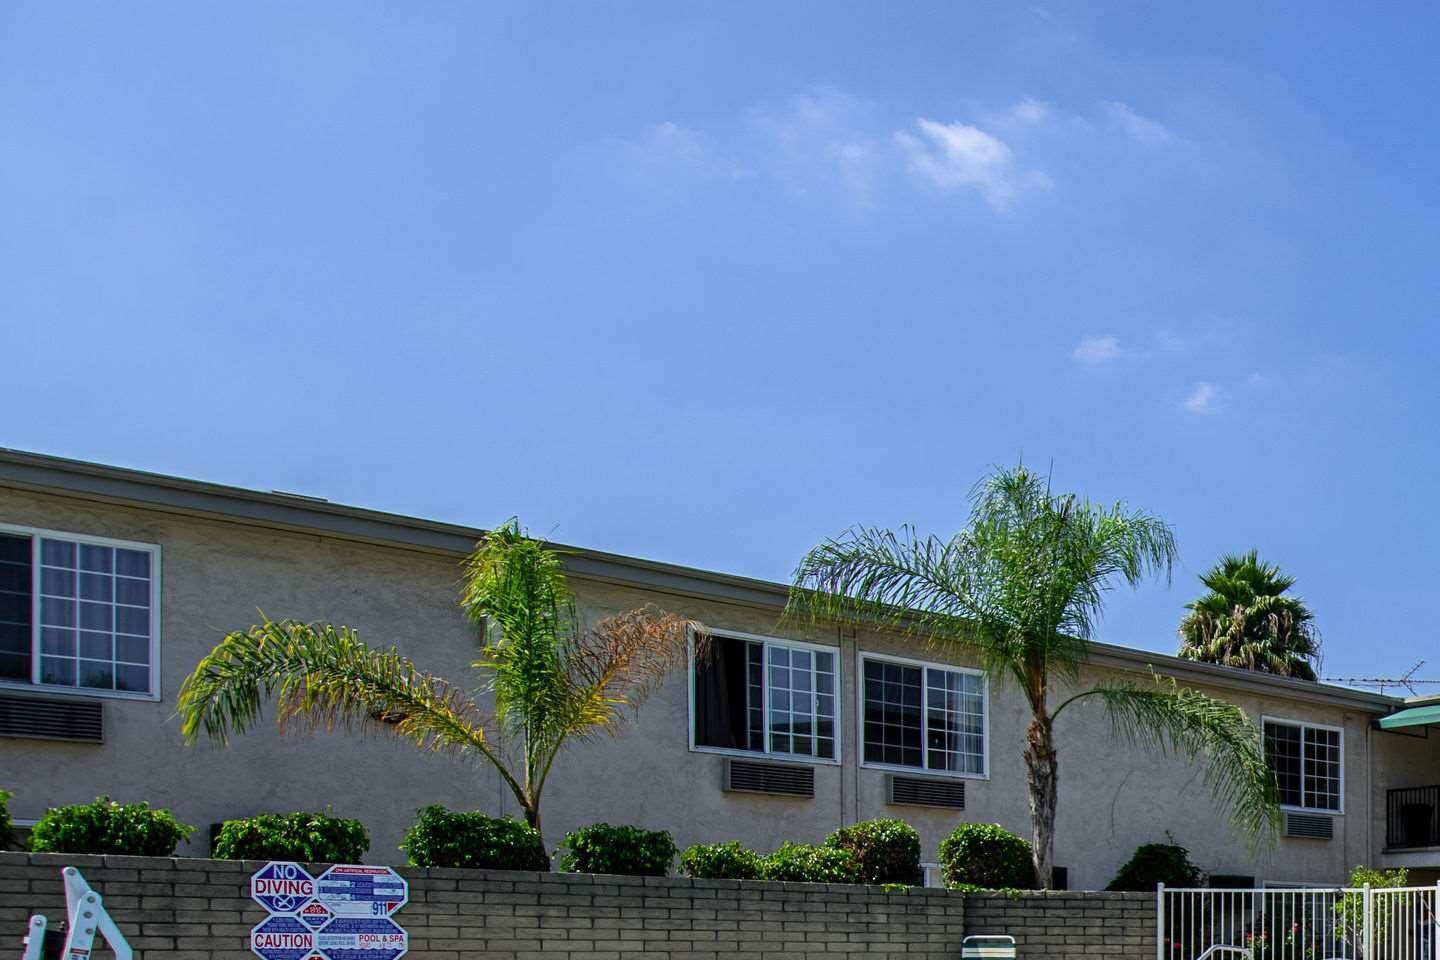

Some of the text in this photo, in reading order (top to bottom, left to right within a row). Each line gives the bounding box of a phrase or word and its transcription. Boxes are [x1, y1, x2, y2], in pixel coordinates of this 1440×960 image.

[273, 864, 297, 879] NO
[255, 880, 313, 895] DIVING
[372, 901, 387, 915] 911
[255, 934, 312, 947] CAUTION
[359, 934, 381, 942] POOL
